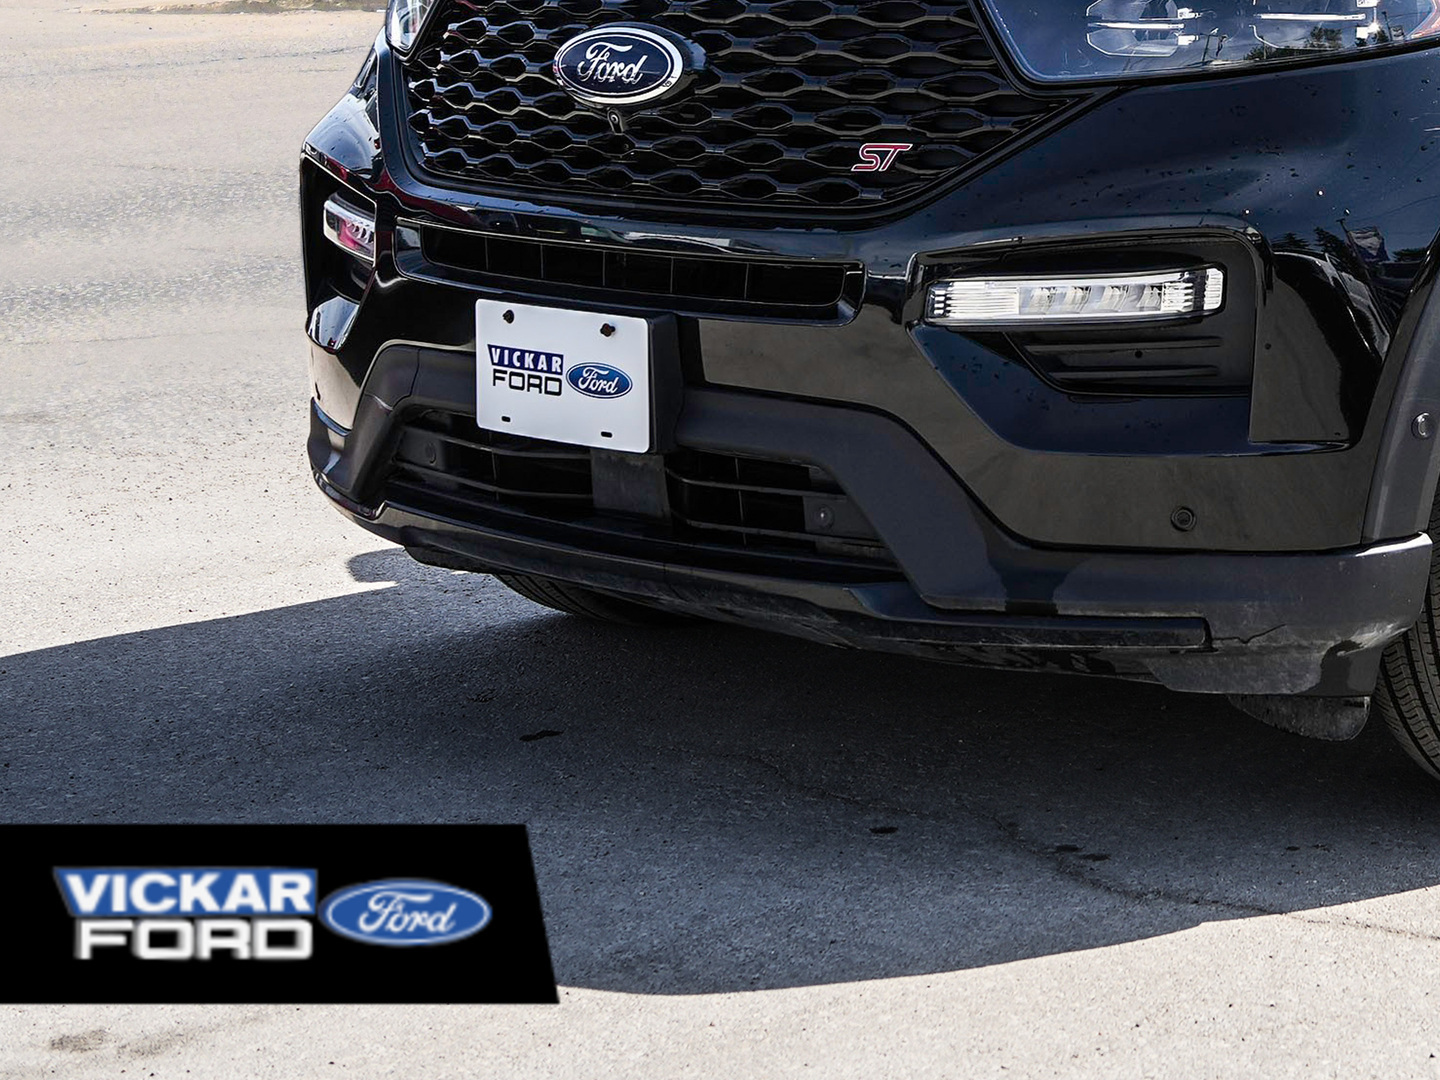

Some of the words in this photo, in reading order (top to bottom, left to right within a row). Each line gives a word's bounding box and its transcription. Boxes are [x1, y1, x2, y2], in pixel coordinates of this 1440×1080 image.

[577, 40, 649, 86] Ford
[851, 142, 913, 172] ST
[491, 347, 563, 373] VICKAR
[493, 368, 563, 397] FORD
[577, 366, 618, 394] Ford
